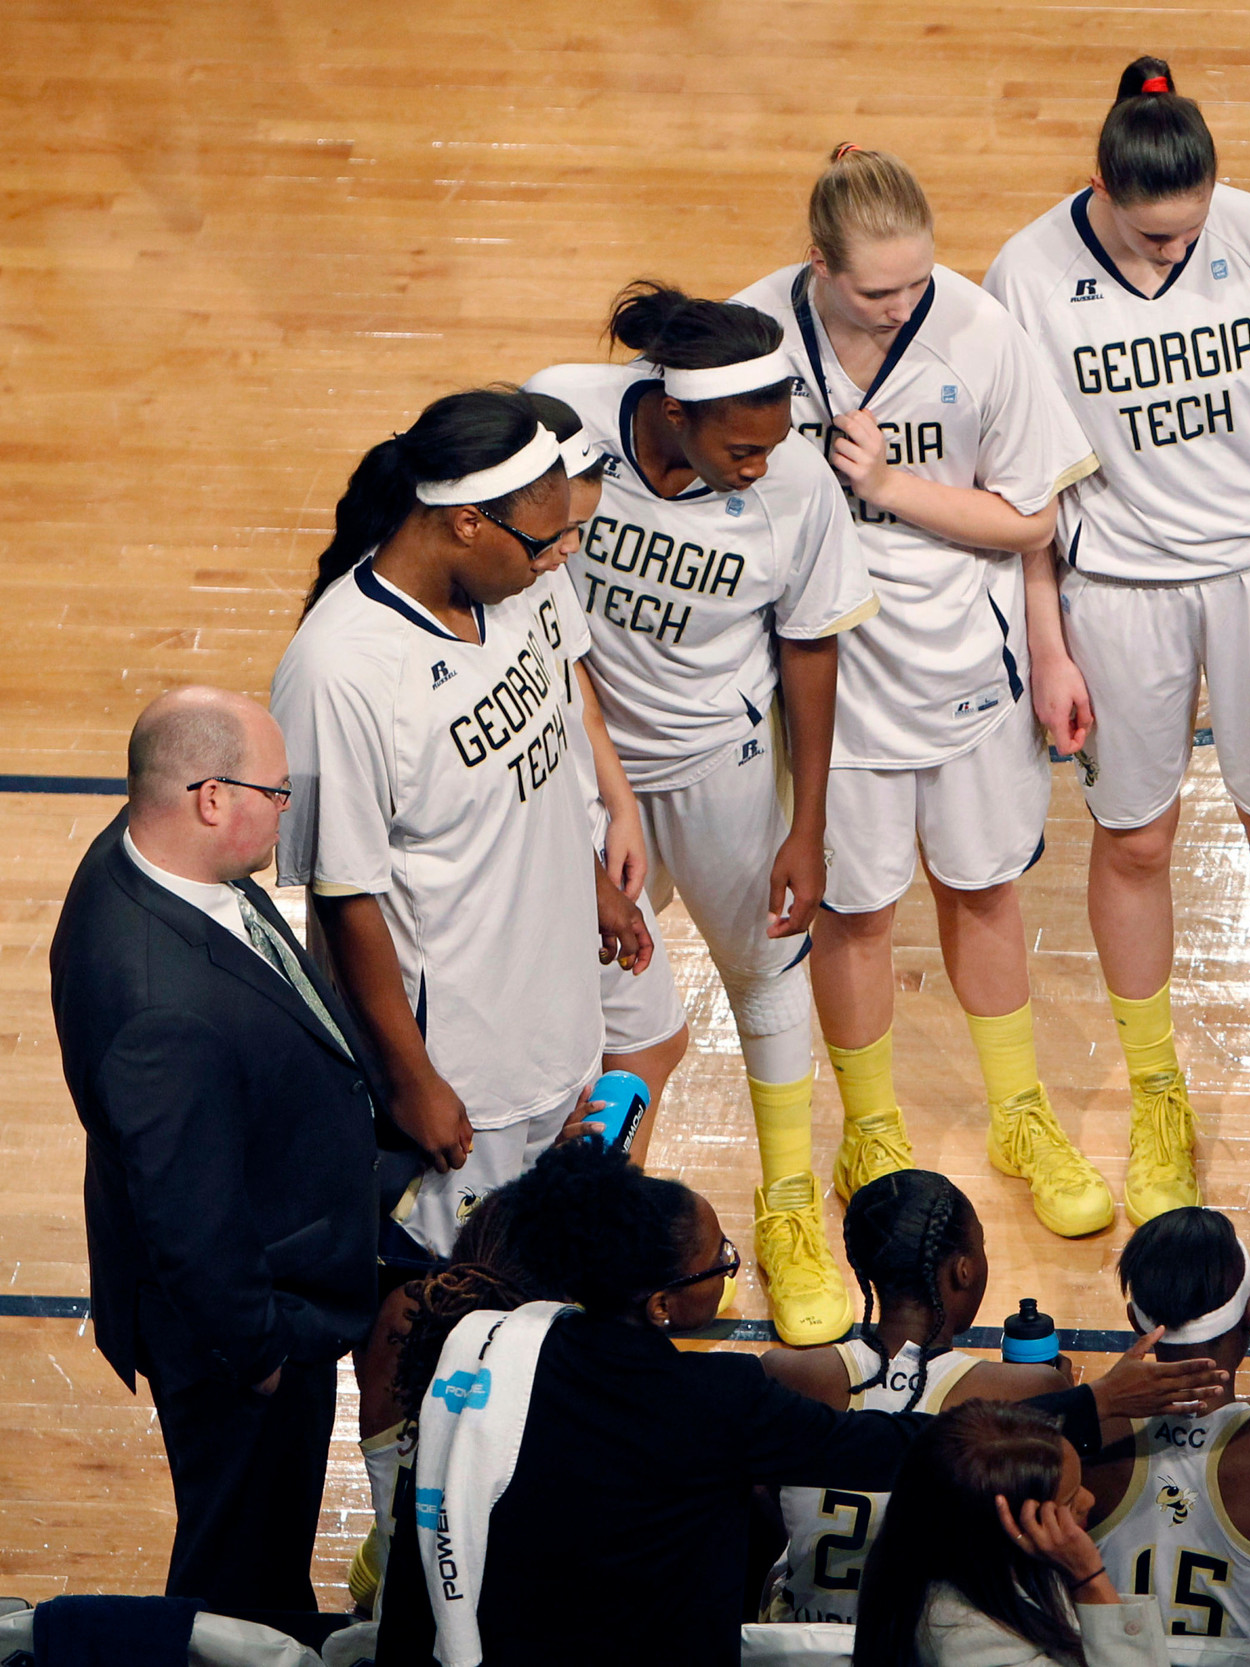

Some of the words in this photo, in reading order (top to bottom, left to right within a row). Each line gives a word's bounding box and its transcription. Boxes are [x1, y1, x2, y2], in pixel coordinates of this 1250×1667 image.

[1070, 293, 1104, 303] RUSSELL
[1119, 390, 1234, 451] TECH
[579, 516, 745, 597] EORGIA
[585, 572, 692, 643] TECH
[432, 669, 457, 690] RUSSELL
[507, 704, 568, 802] TECH
[1154, 1422, 1207, 1448] ACC
